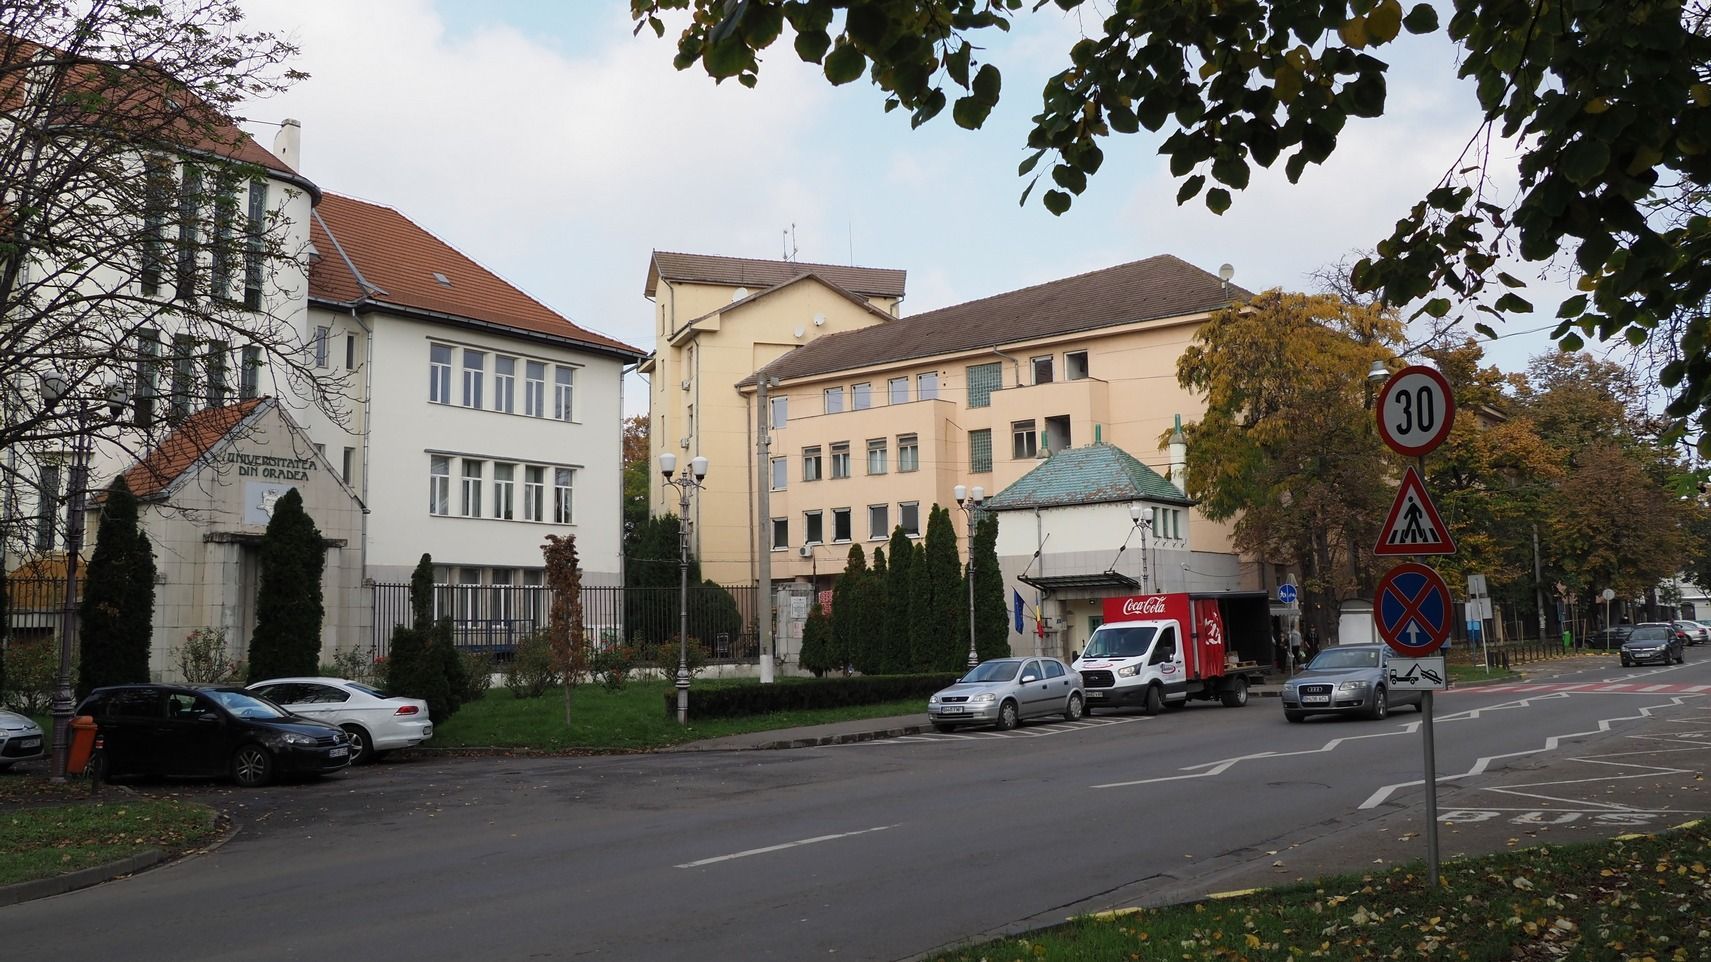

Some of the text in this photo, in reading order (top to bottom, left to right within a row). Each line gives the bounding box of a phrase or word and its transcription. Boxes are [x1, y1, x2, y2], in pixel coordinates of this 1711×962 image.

[1395, 386, 1434, 435] 30
[227, 453, 317, 470] UNIVERSITATEA
[238, 466, 310, 481] DIN ORADEA
[1123, 596, 1167, 615] Coca-Cola
[1436, 810, 1658, 826] BUS
